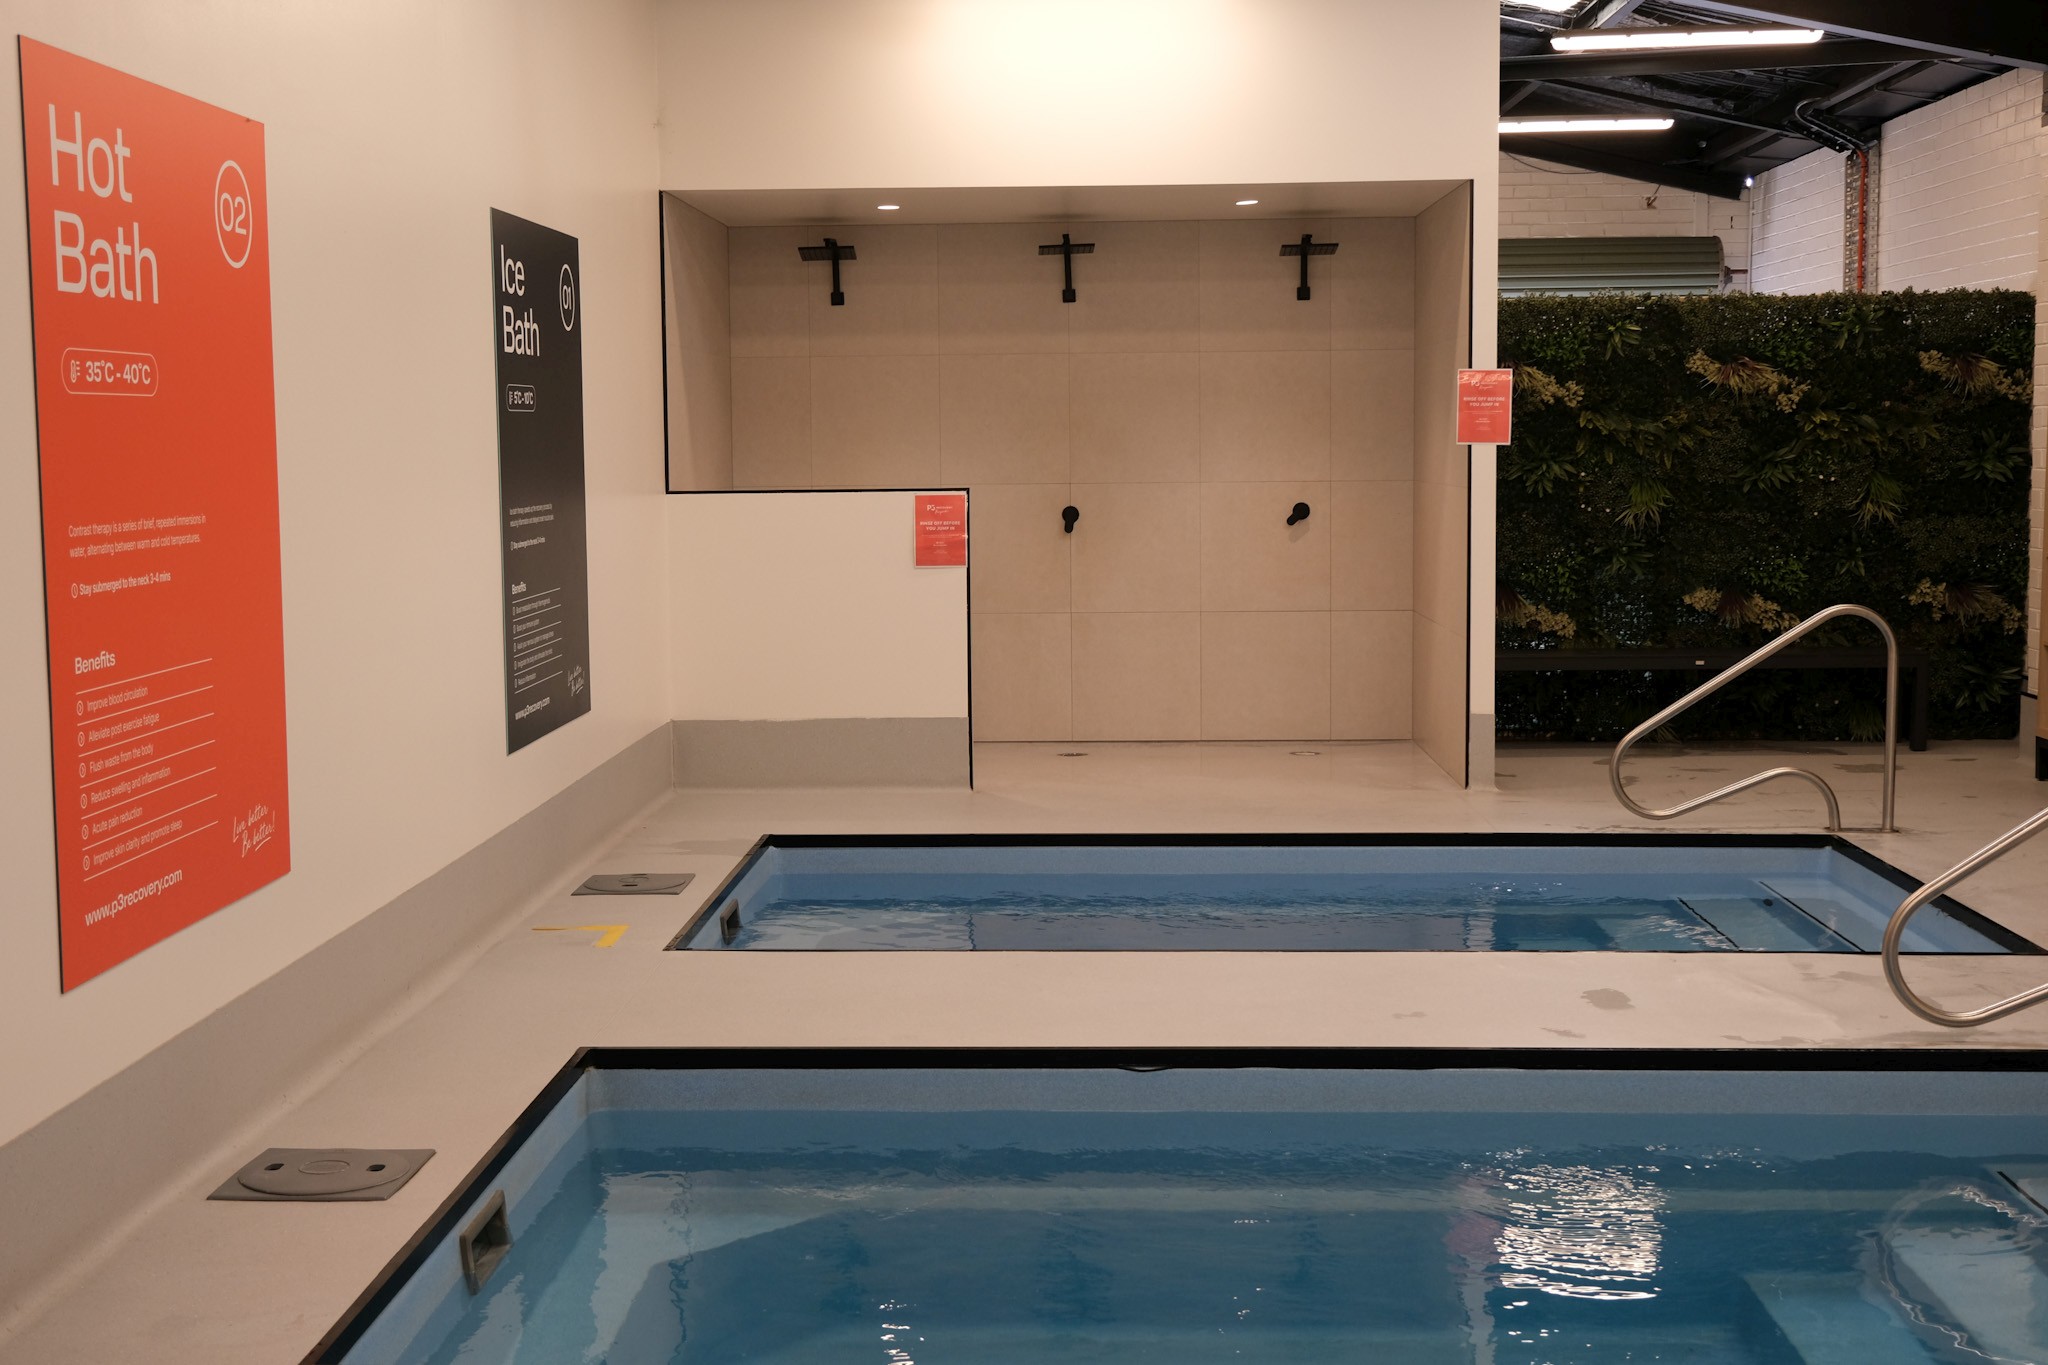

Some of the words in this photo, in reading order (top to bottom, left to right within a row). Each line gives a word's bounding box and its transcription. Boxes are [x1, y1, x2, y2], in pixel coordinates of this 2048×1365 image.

[48, 103, 133, 203] Hot
[219, 192, 247, 235] 02
[54, 209, 159, 304] Bath
[500, 244, 525, 296] Ice
[562, 285, 572, 310] 01
[503, 305, 540, 356] Bath
[69, 525, 92, 537] Contrast
[92, 523, 112, 536] therapy
[113, 520, 117, 532] is
[118, 523, 121, 532] a
[122, 520, 137, 532] series
[137, 518, 143, 530] of
[143, 517, 155, 530] brief,
[155, 516, 176, 530] repeated
[176, 514, 201, 526] immersions
[201, 513, 206, 524] in
[70, 547, 86, 558] water,
[87, 543, 114, 556] alternating
[114, 541, 136, 552] between
[136, 540, 150, 550] warm
[150, 537, 160, 548] and
[160, 536, 170, 547] cold
[79, 583, 92, 597] Stay
[92, 580, 122, 593] submerged
[122, 578, 128, 589] to
[128, 576, 137, 587] the
[137, 574, 149, 585] neck
[149, 571, 159, 584] 3-4
[159, 570, 171, 582] mins
[75, 651, 116, 675] Benefits
[87, 697, 109, 713] Improve
[109, 691, 124, 706] blood
[123, 687, 149, 702] circulation
[89, 727, 111, 742] Alleviate
[110, 723, 123, 738] post
[122, 716, 143, 732] exercise
[143, 712, 160, 727] fatigue
[90, 759, 104, 774] Flush
[104, 755, 120, 768] waste
[120, 750, 133, 763] from
[132, 746, 142, 759] the
[141, 743, 154, 756] body
[91, 789, 111, 804] Reduce
[111, 781, 132, 794] swelling
[131, 777, 141, 790] and
[141, 766, 171, 781] inflammation
[92, 820, 108, 835] Acute
[107, 814, 120, 831] pain
[119, 806, 143, 823] reduction
[233, 816, 247, 843] Live
[248, 803, 268, 826] better
[94, 848, 115, 866] Improve
[114, 842, 126, 857] skin
[125, 836, 141, 850] clarity
[140, 831, 151, 846] and
[150, 824, 170, 843] promote
[170, 819, 183, 834] sleep
[242, 830, 252, 858] Be
[84, 869, 183, 927] www.p3recovery.com
